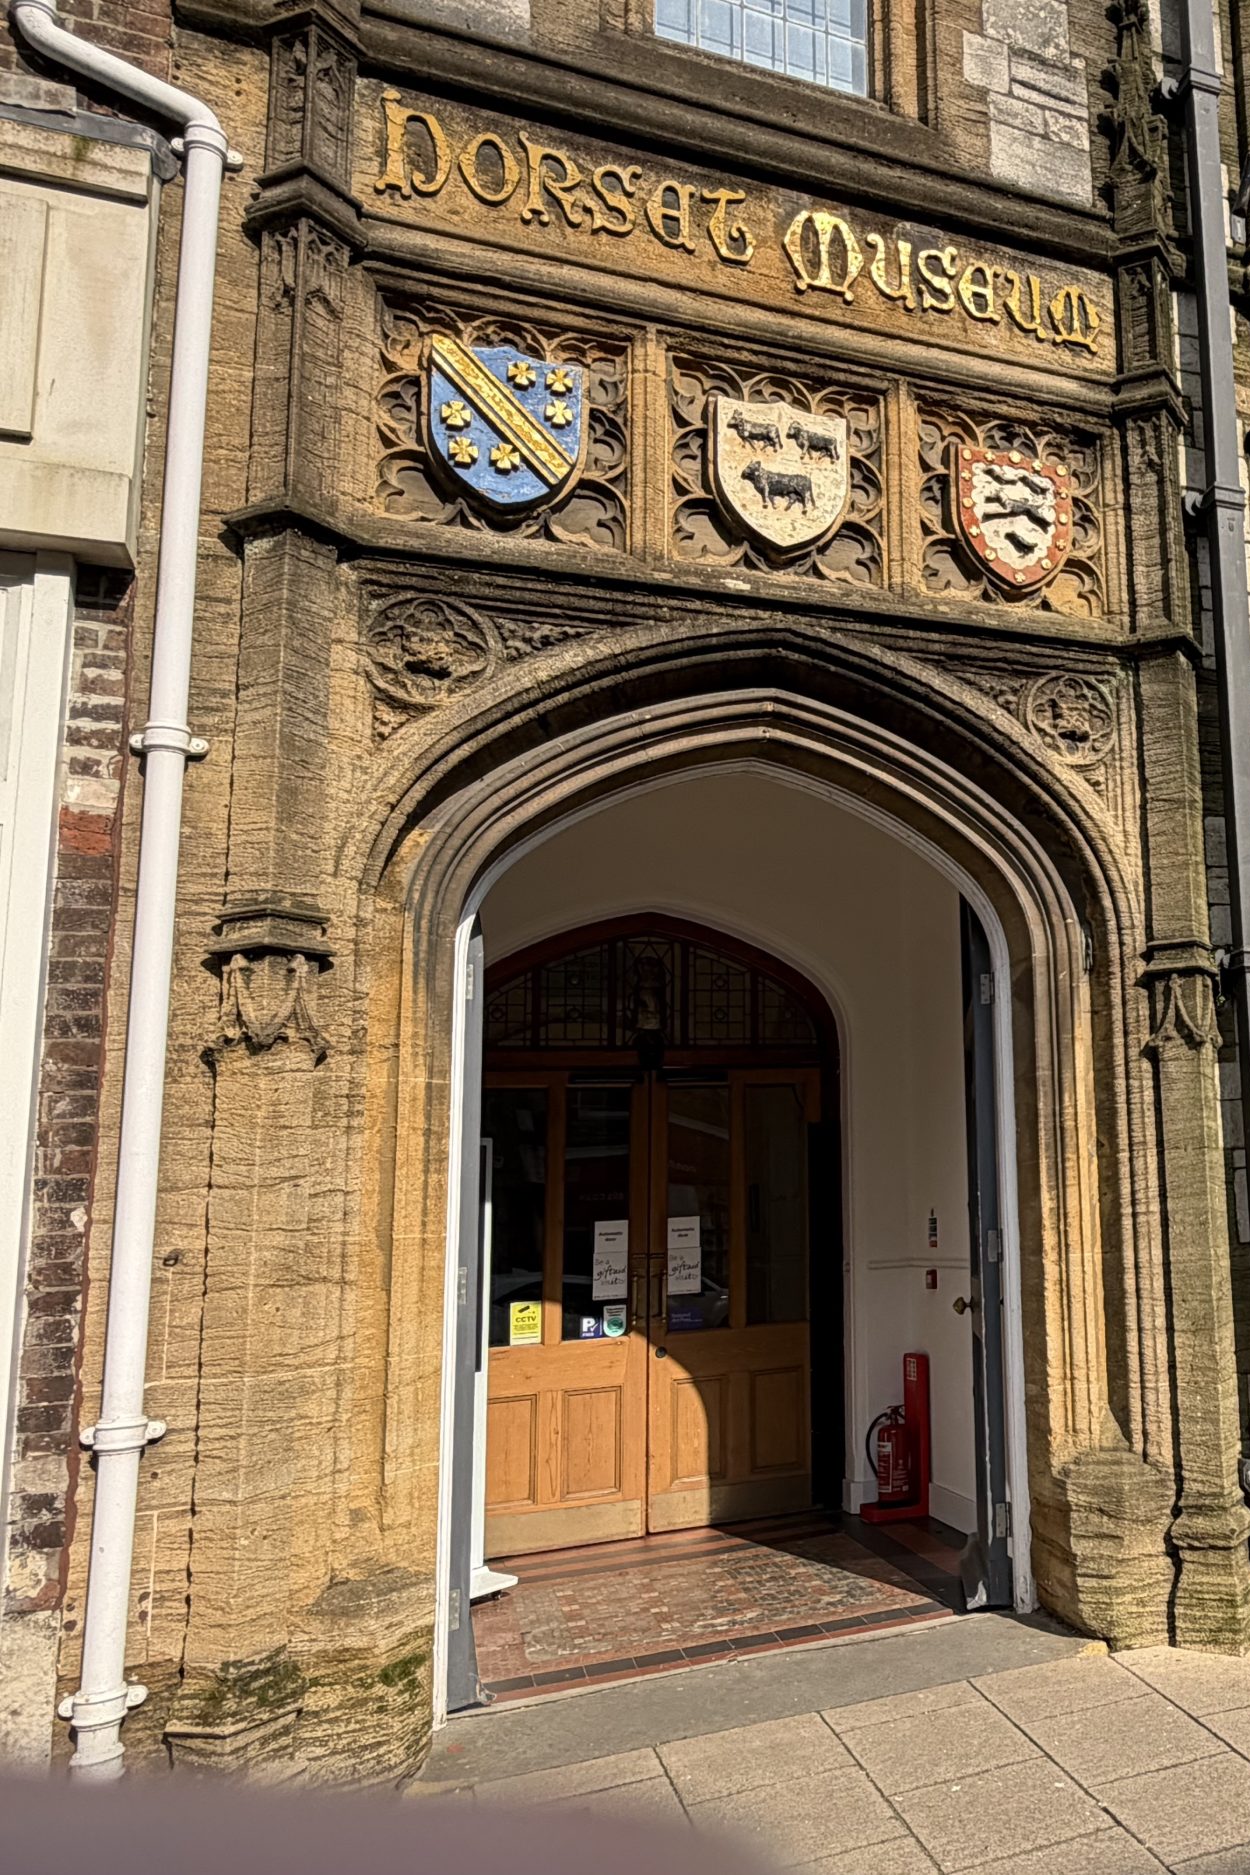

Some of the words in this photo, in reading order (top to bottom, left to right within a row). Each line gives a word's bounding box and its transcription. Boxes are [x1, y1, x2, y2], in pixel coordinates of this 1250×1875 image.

[374, 89, 756, 265] DORSET
[782, 209, 1103, 353] MUSEUM
[515, 1315, 537, 1323] CCTV
